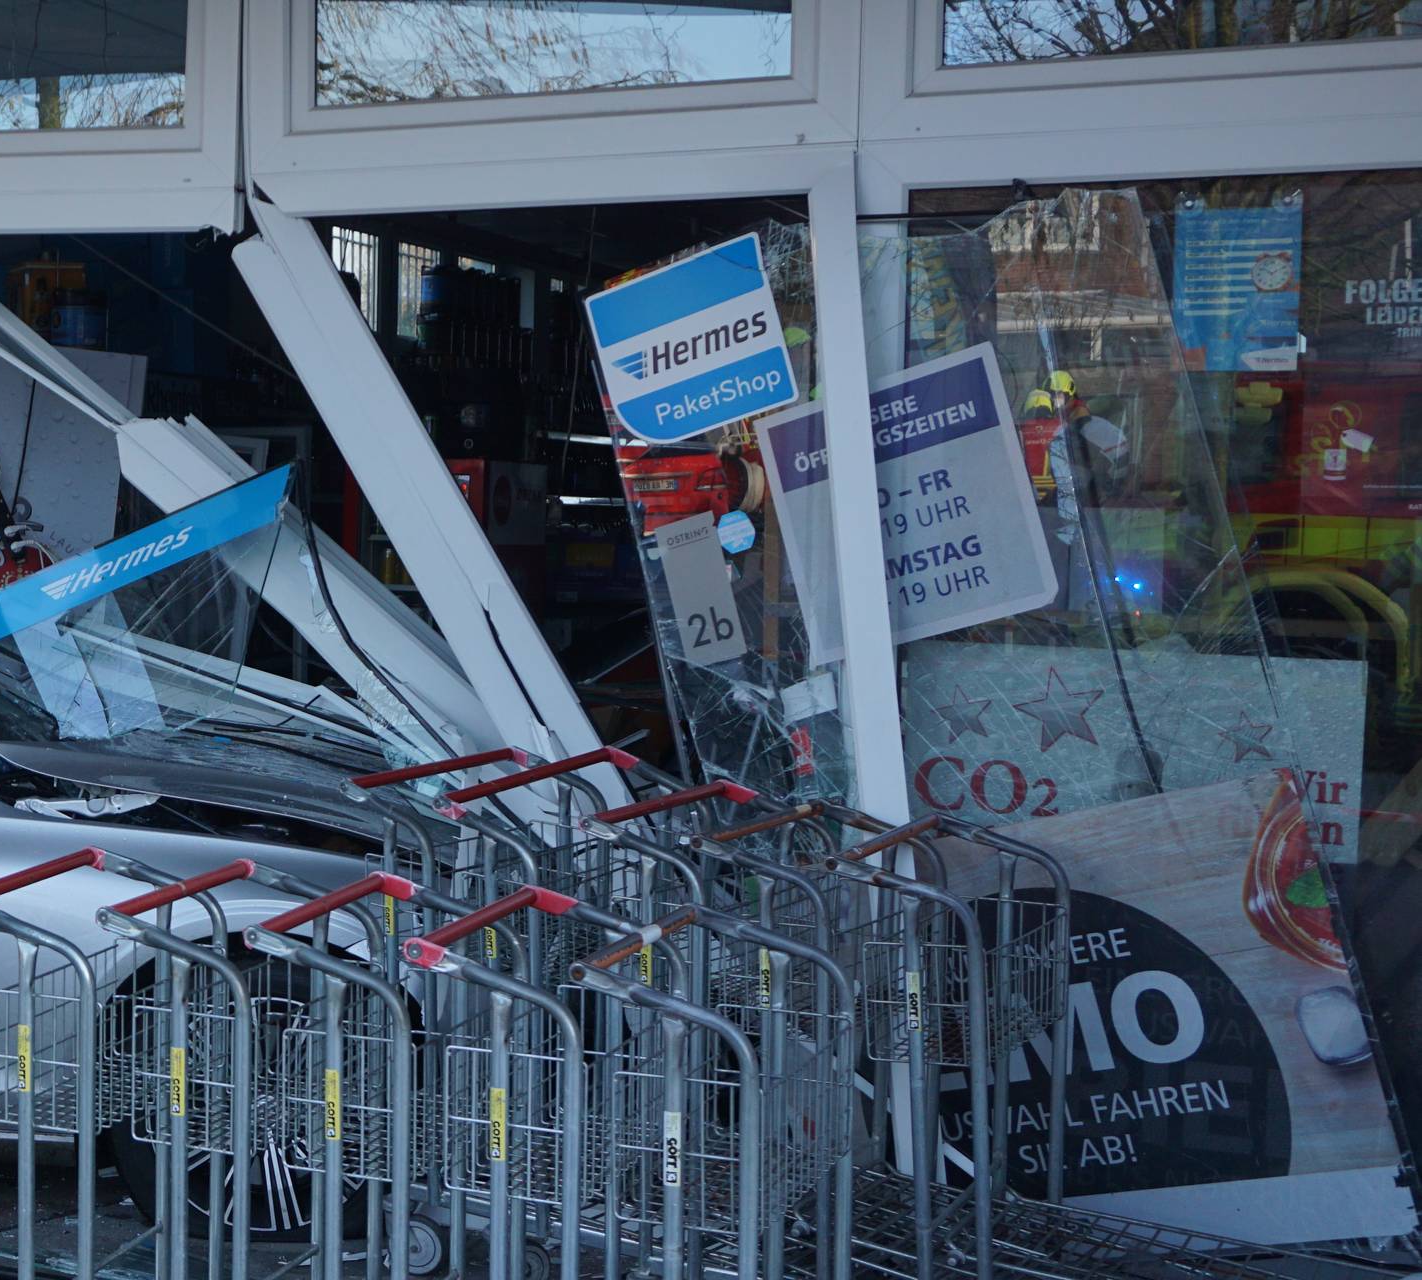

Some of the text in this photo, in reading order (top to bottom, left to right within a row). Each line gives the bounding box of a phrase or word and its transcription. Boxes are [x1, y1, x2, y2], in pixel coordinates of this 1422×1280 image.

[1365, 305, 1422, 326] LEIDE
[650, 309, 768, 375] Hermes
[654, 366, 783, 426] PaketShop
[871, 395, 919, 425] SERE
[918, 468, 952, 497] FR
[916, 495, 971, 528] UHR
[666, 526, 709, 546] OSTRING
[885, 534, 983, 580] MSTAG
[69, 524, 194, 596] Hermes
[899, 565, 990, 607] 19 UHR
[687, 606, 734, 649] 2b
[1090, 1079, 1231, 1125] FAHREN
[1018, 1133, 1139, 1174] SI AB!
